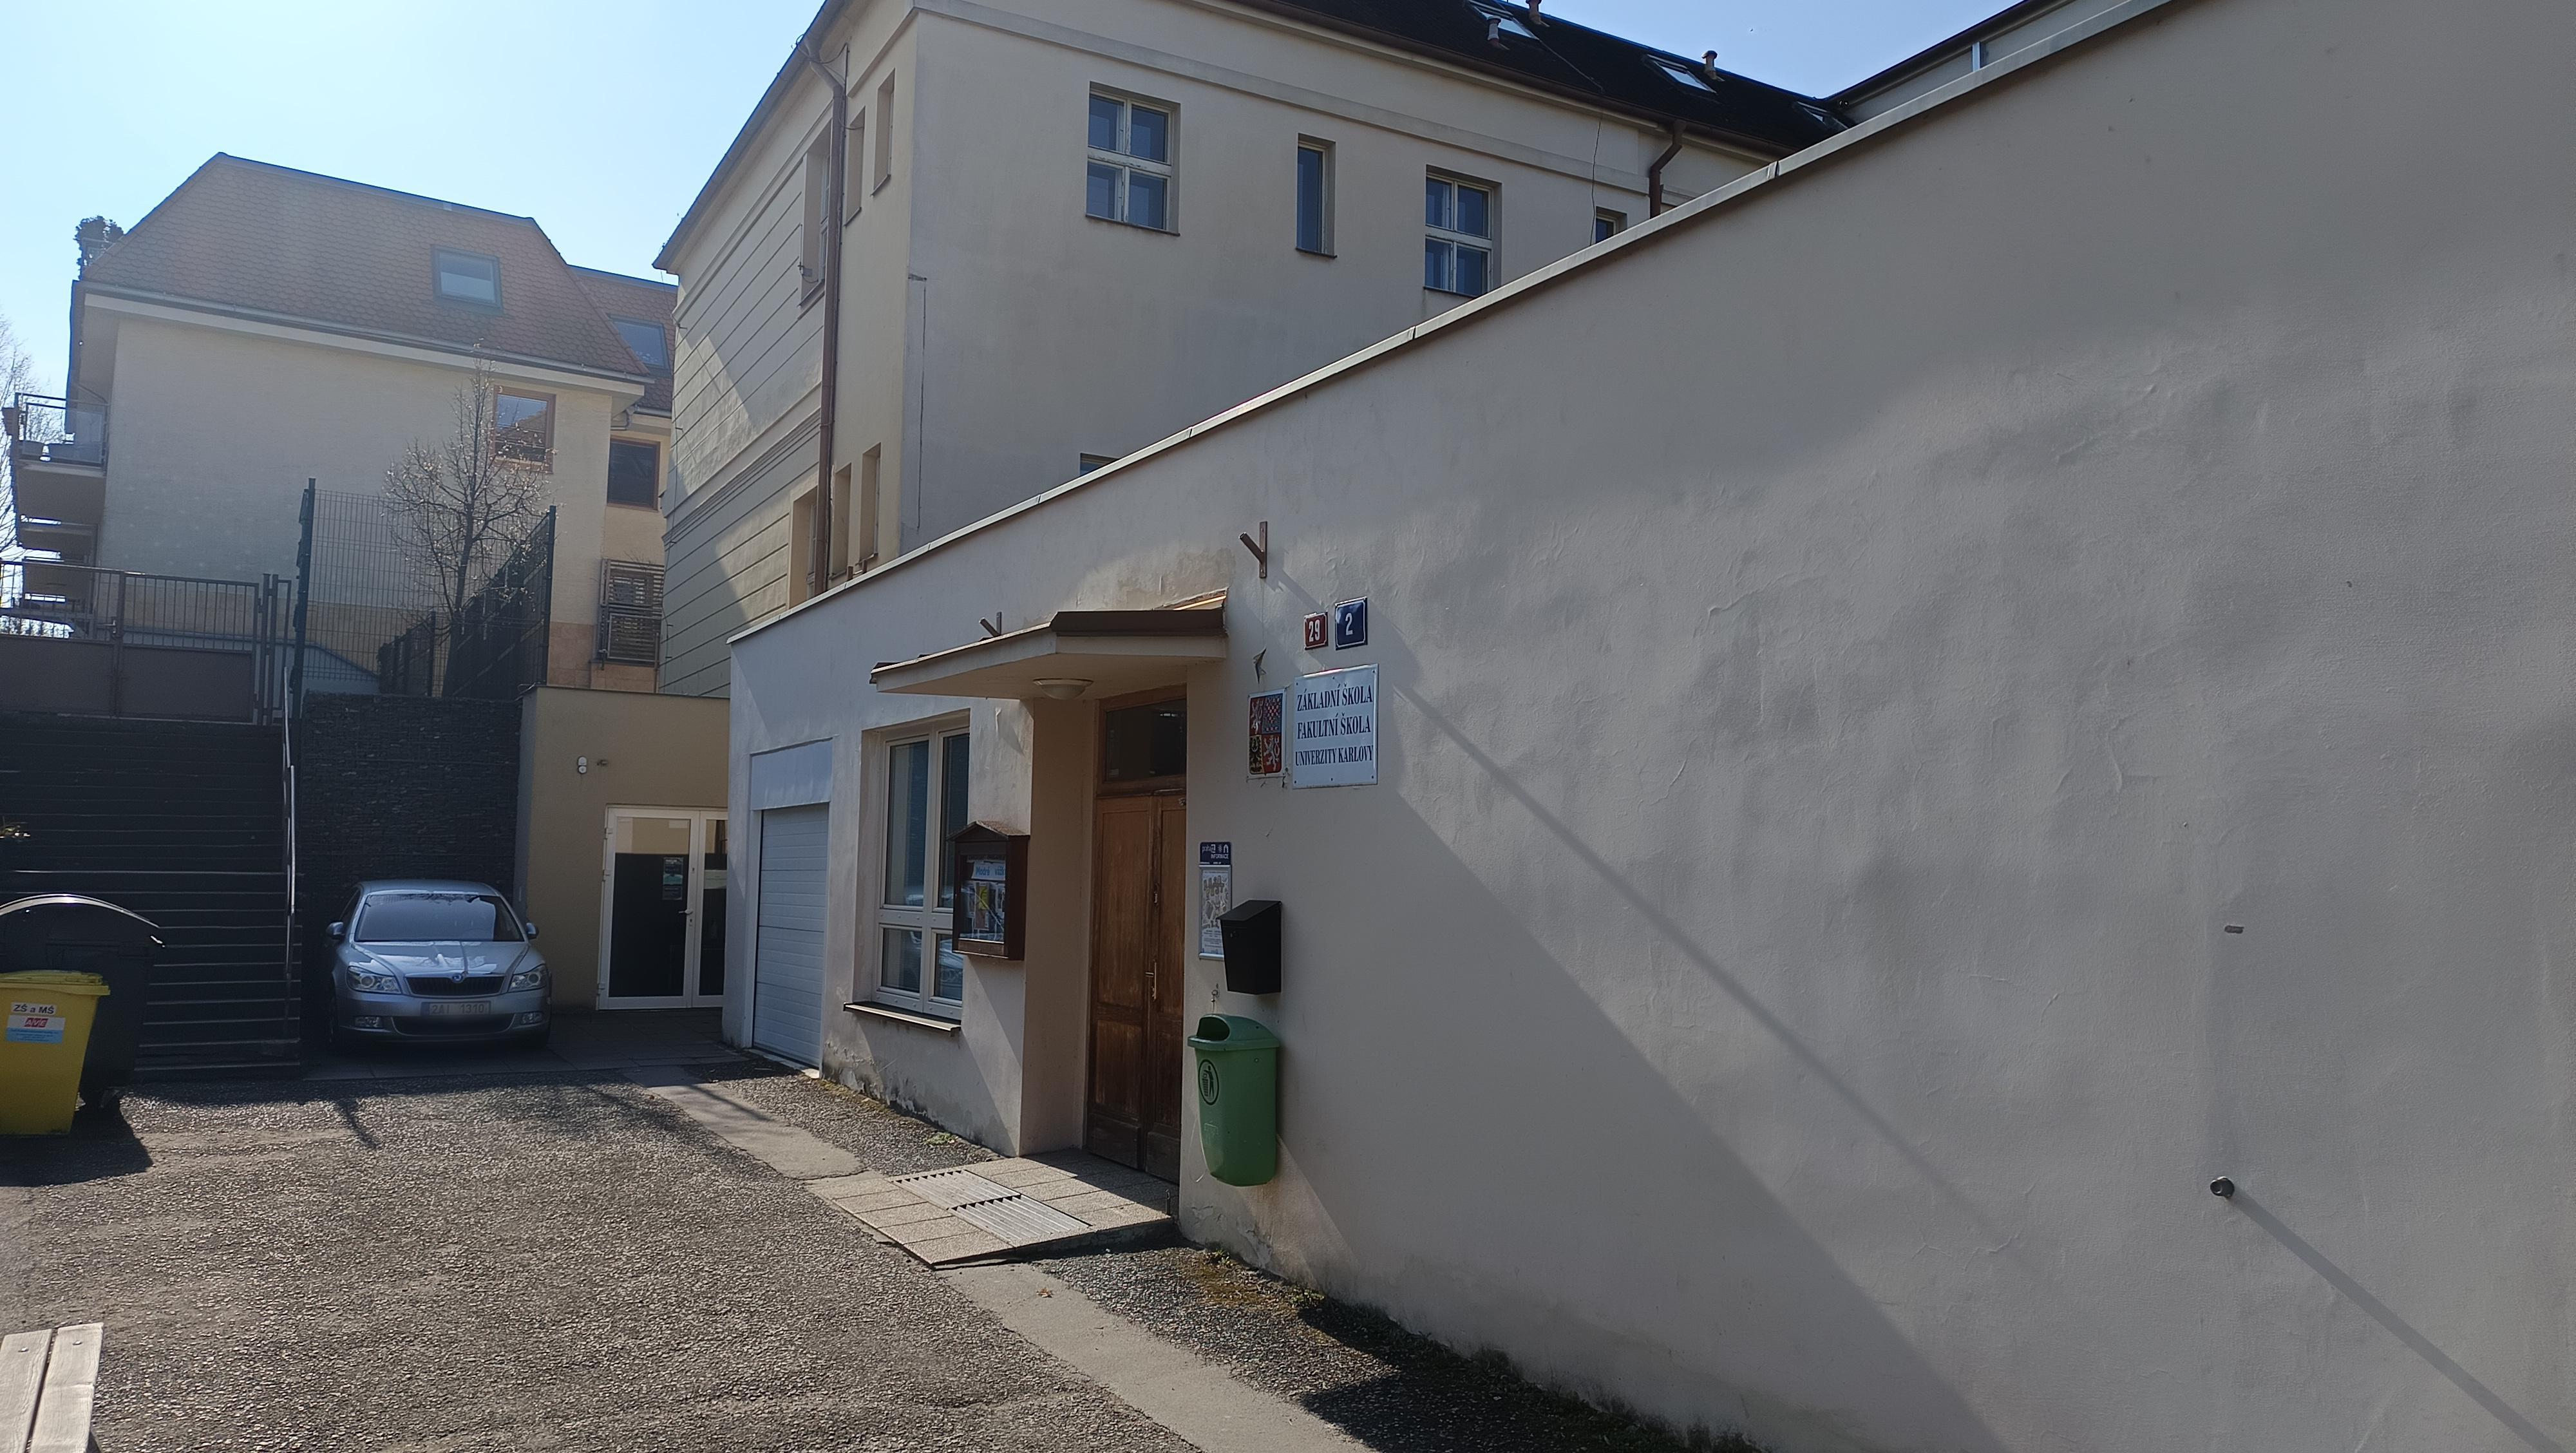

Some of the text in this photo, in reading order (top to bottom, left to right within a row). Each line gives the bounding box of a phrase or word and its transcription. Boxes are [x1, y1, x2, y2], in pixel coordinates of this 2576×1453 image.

[1309, 620, 1320, 642] 29
[1345, 613, 1353, 636] 2
[1297, 683, 1373, 711] ZÁKLADNÍ ŠKOLA
[1297, 712, 1371, 739] FAKULTNÍ ŠKOLA
[1295, 745, 1374, 766] UNIVERZITY KARLOVY
[13, 1003, 28, 1012] ZŠ
[39, 1005, 54, 1014] MŠ
[459, 1003, 485, 1014] 1310
[24, 1018, 48, 1027] AVE
